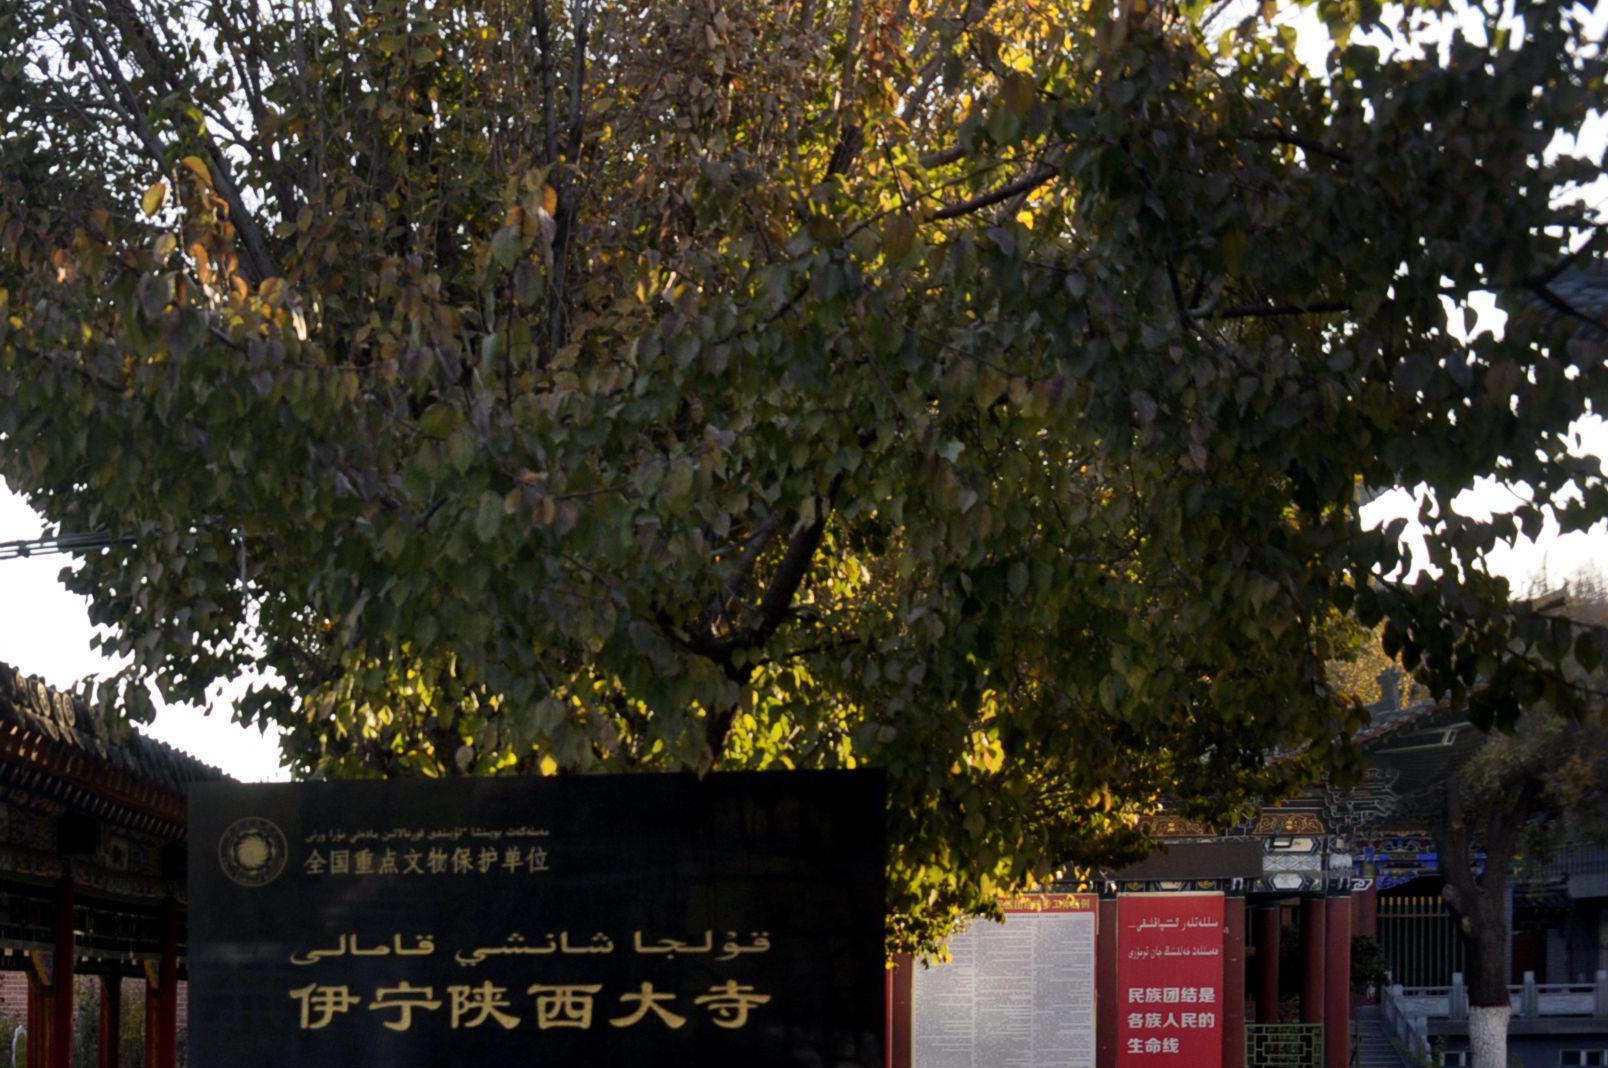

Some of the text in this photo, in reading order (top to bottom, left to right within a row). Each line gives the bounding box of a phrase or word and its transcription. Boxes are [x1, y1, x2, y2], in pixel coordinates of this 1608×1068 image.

[304, 846, 550, 875] 全国重点文物保护单位
[1127, 987, 1216, 1004] 民族团结是
[289, 980, 772, 1031] 伊宁陕西大寺
[1127, 1012, 1216, 1029] 各族人民的
[1127, 1037, 1180, 1054] 生命线
